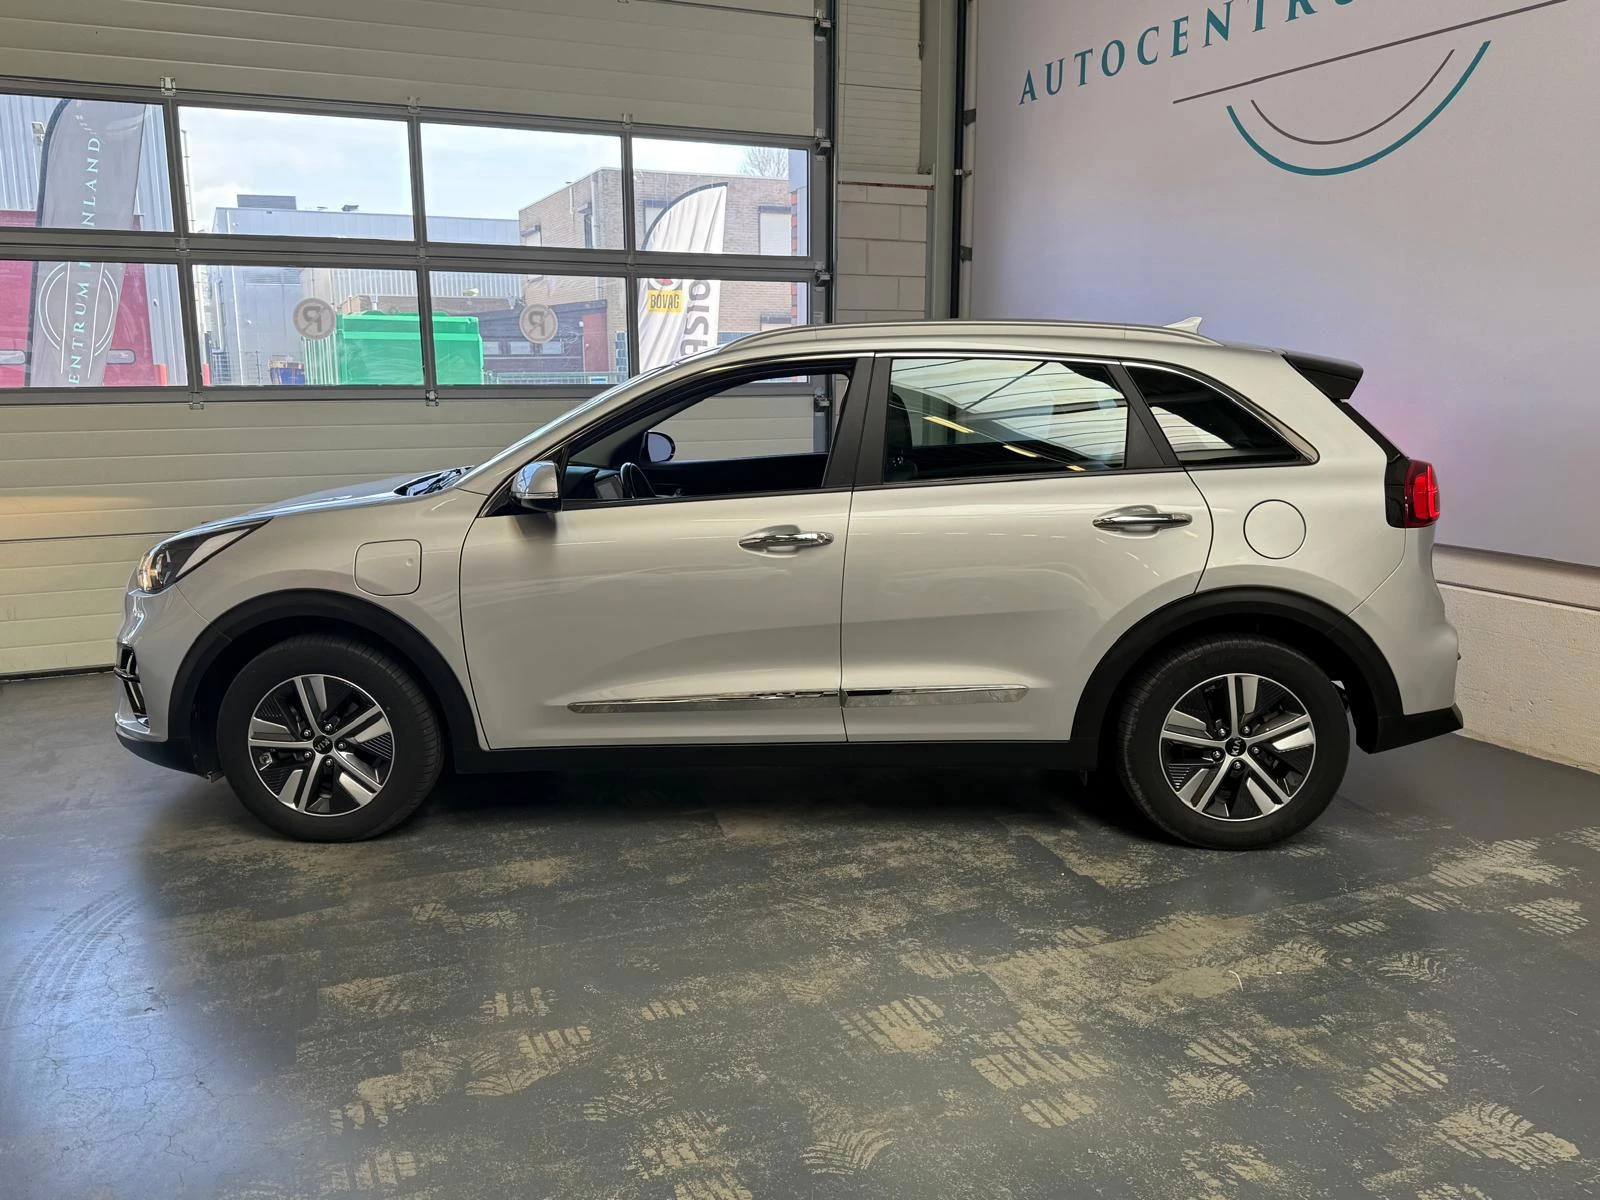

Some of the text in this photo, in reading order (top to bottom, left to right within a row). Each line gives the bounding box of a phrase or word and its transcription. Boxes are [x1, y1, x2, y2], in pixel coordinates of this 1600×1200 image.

[79, 138, 101, 268] NLAND
[650, 294, 680, 309] BOVAG
[1230, 739, 1242, 756] KIA
